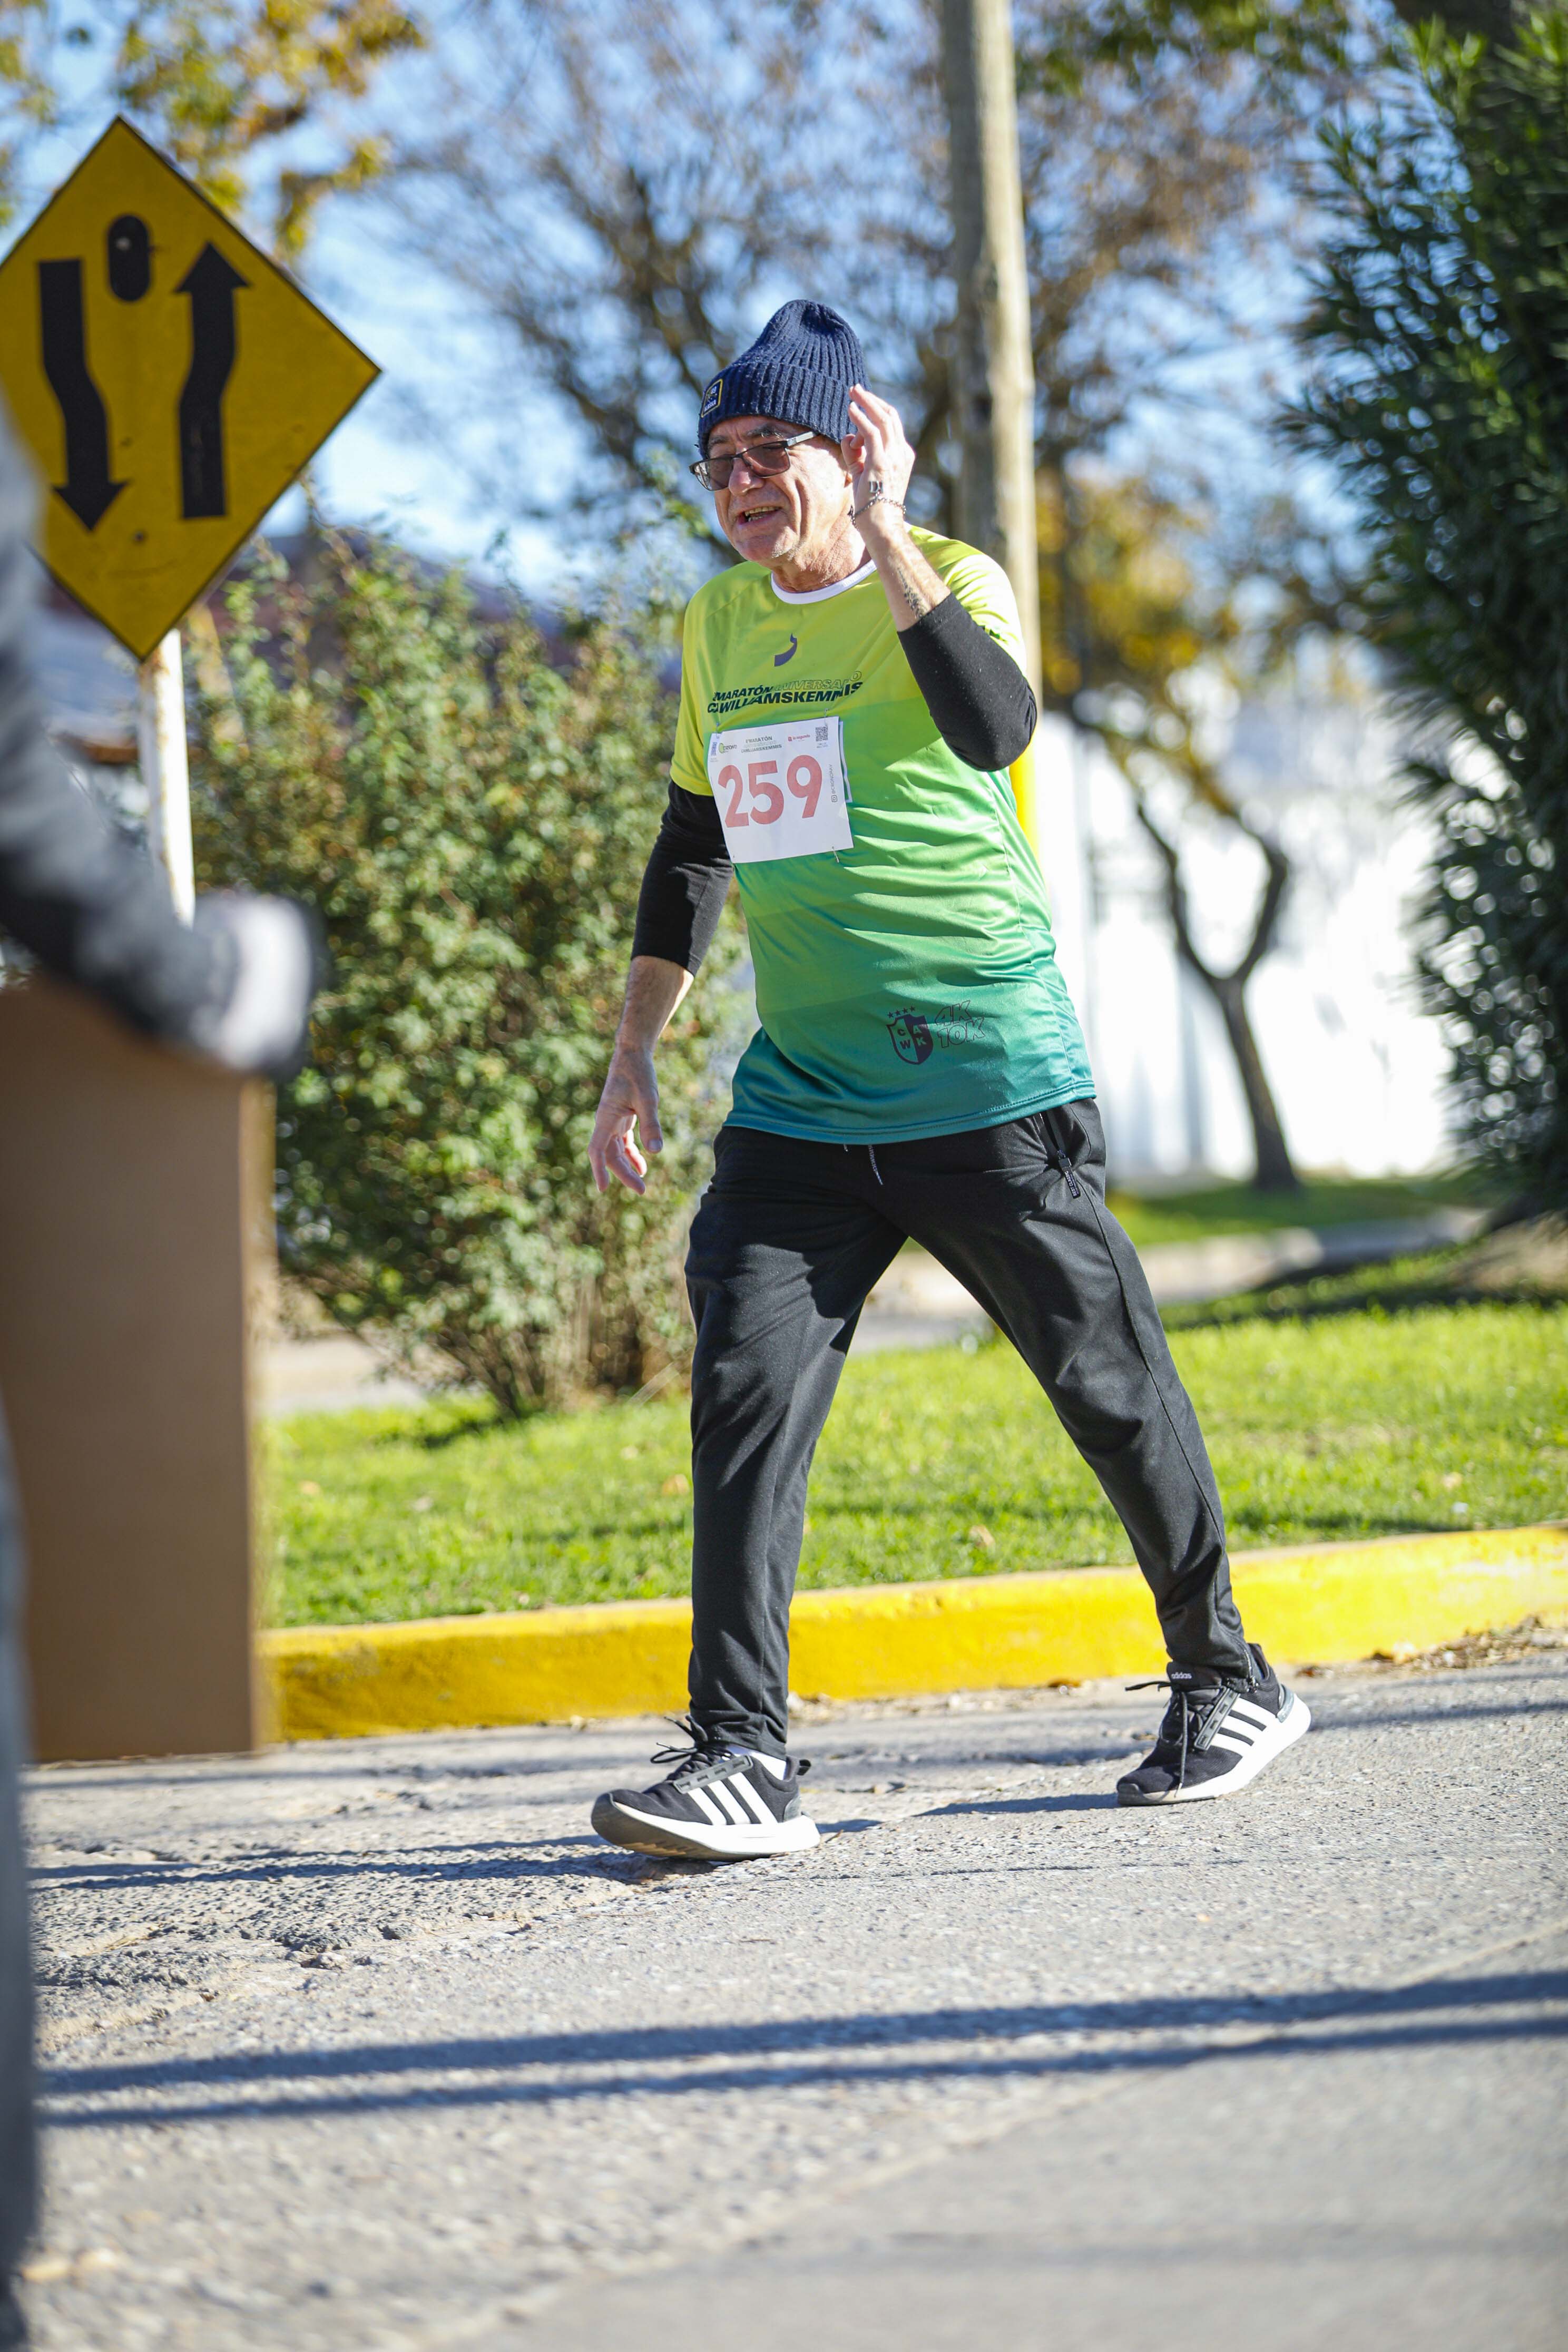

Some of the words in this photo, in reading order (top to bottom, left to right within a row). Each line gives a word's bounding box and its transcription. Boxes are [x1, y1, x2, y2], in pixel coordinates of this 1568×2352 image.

[718, 754, 822, 828] 259
[935, 1000, 972, 1025] 4K
[937, 1016, 986, 1048] 10K
